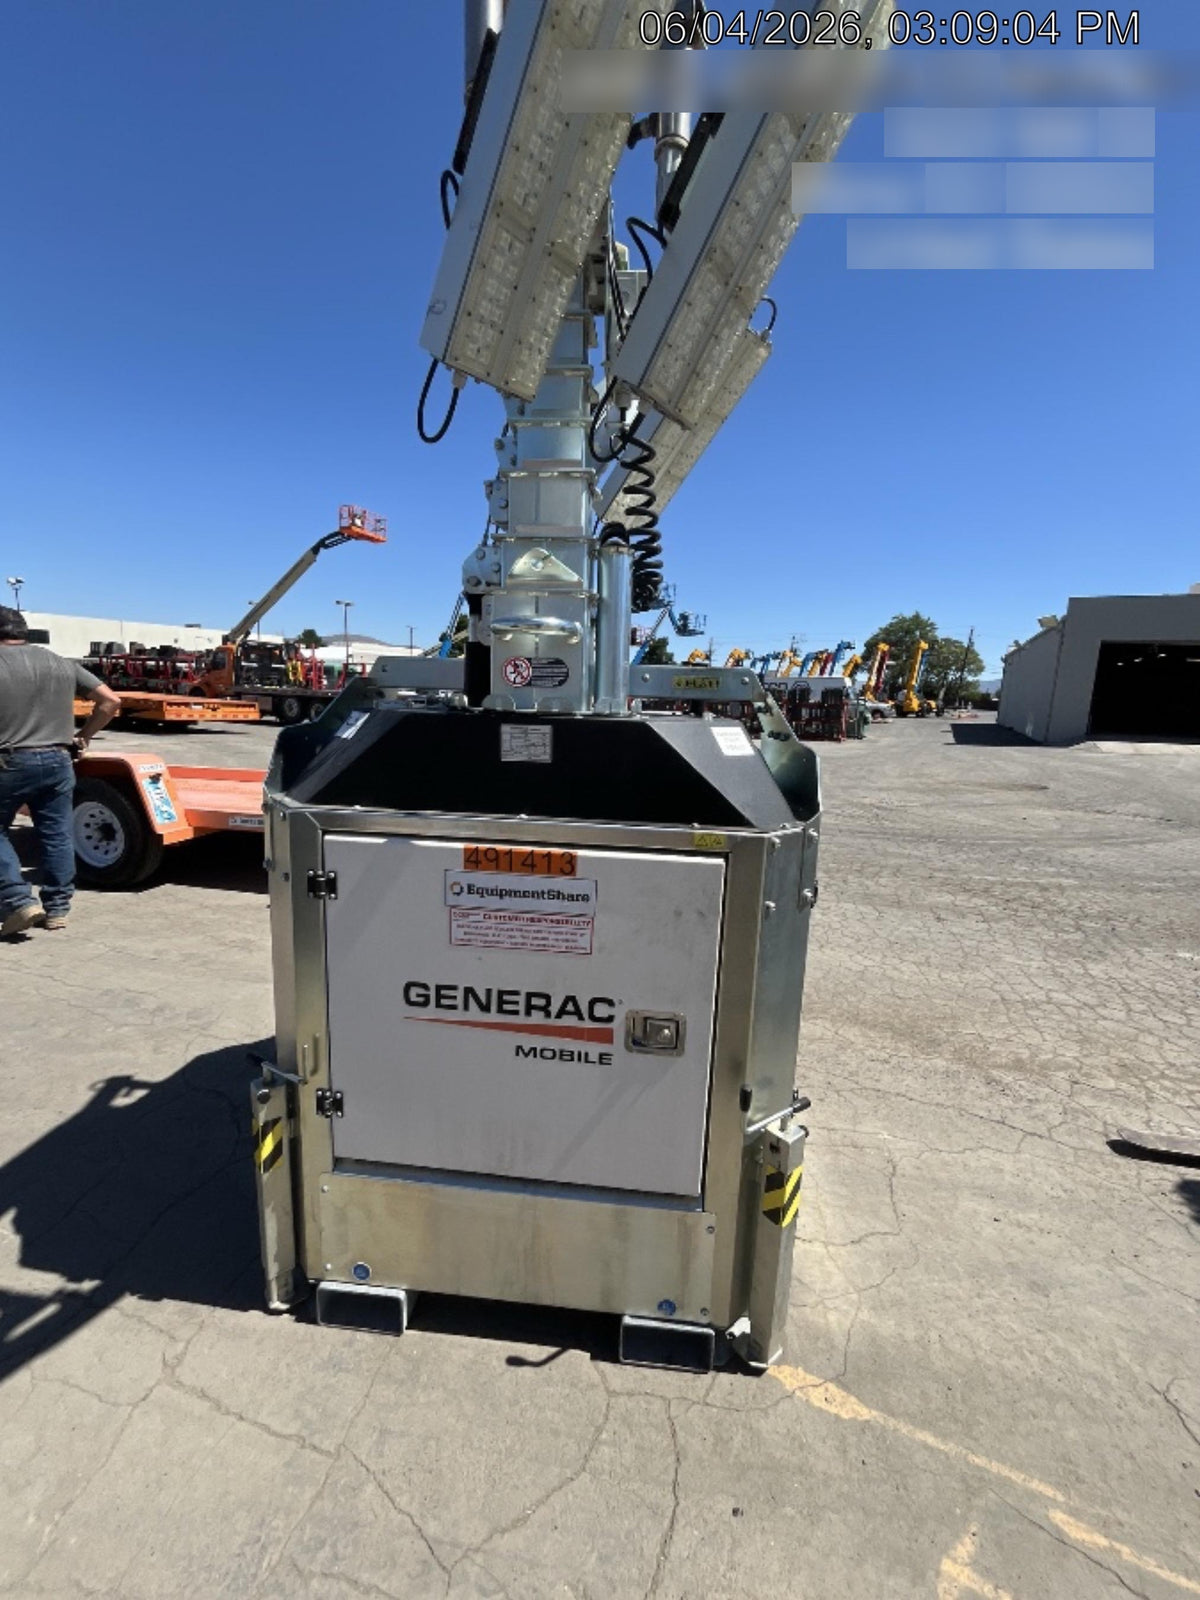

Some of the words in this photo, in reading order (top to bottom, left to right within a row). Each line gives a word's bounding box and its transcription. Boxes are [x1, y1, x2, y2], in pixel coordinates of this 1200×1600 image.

[465, 845, 576, 876] 491413
[466, 883, 590, 903] EquipmentShare
[403, 981, 616, 1023] GENERAC
[514, 1045, 613, 1065] MOBILE
